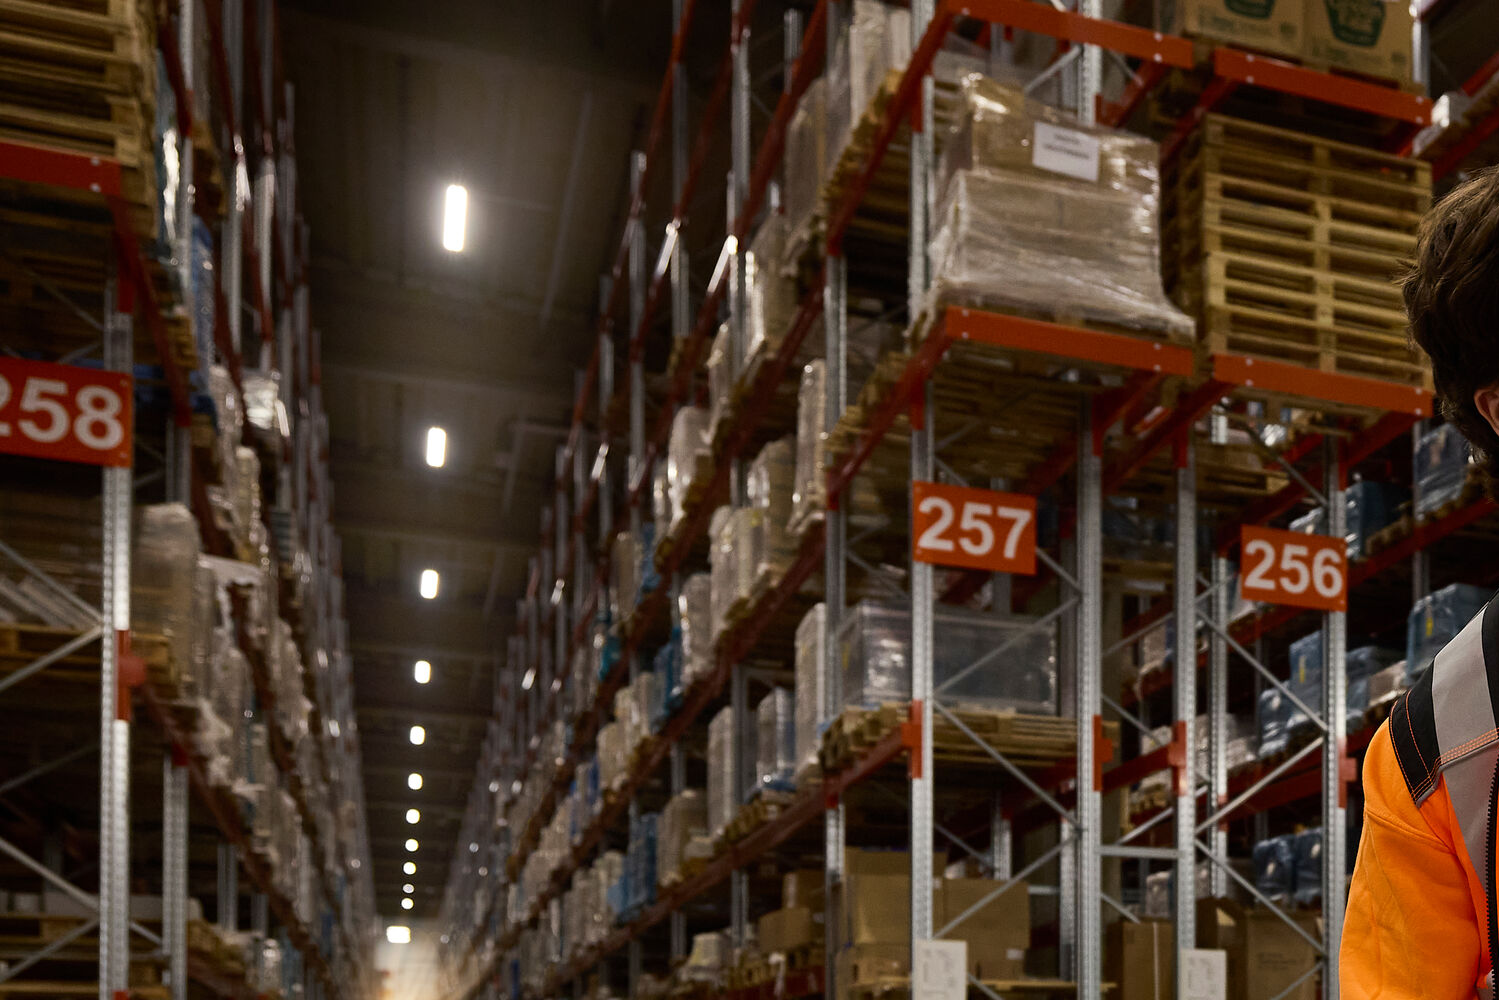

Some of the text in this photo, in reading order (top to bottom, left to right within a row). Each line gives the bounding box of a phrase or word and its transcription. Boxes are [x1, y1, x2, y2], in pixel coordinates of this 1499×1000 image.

[0, 374, 124, 451] 58
[917, 496, 1032, 559] 257
[1244, 539, 1343, 598] 256
